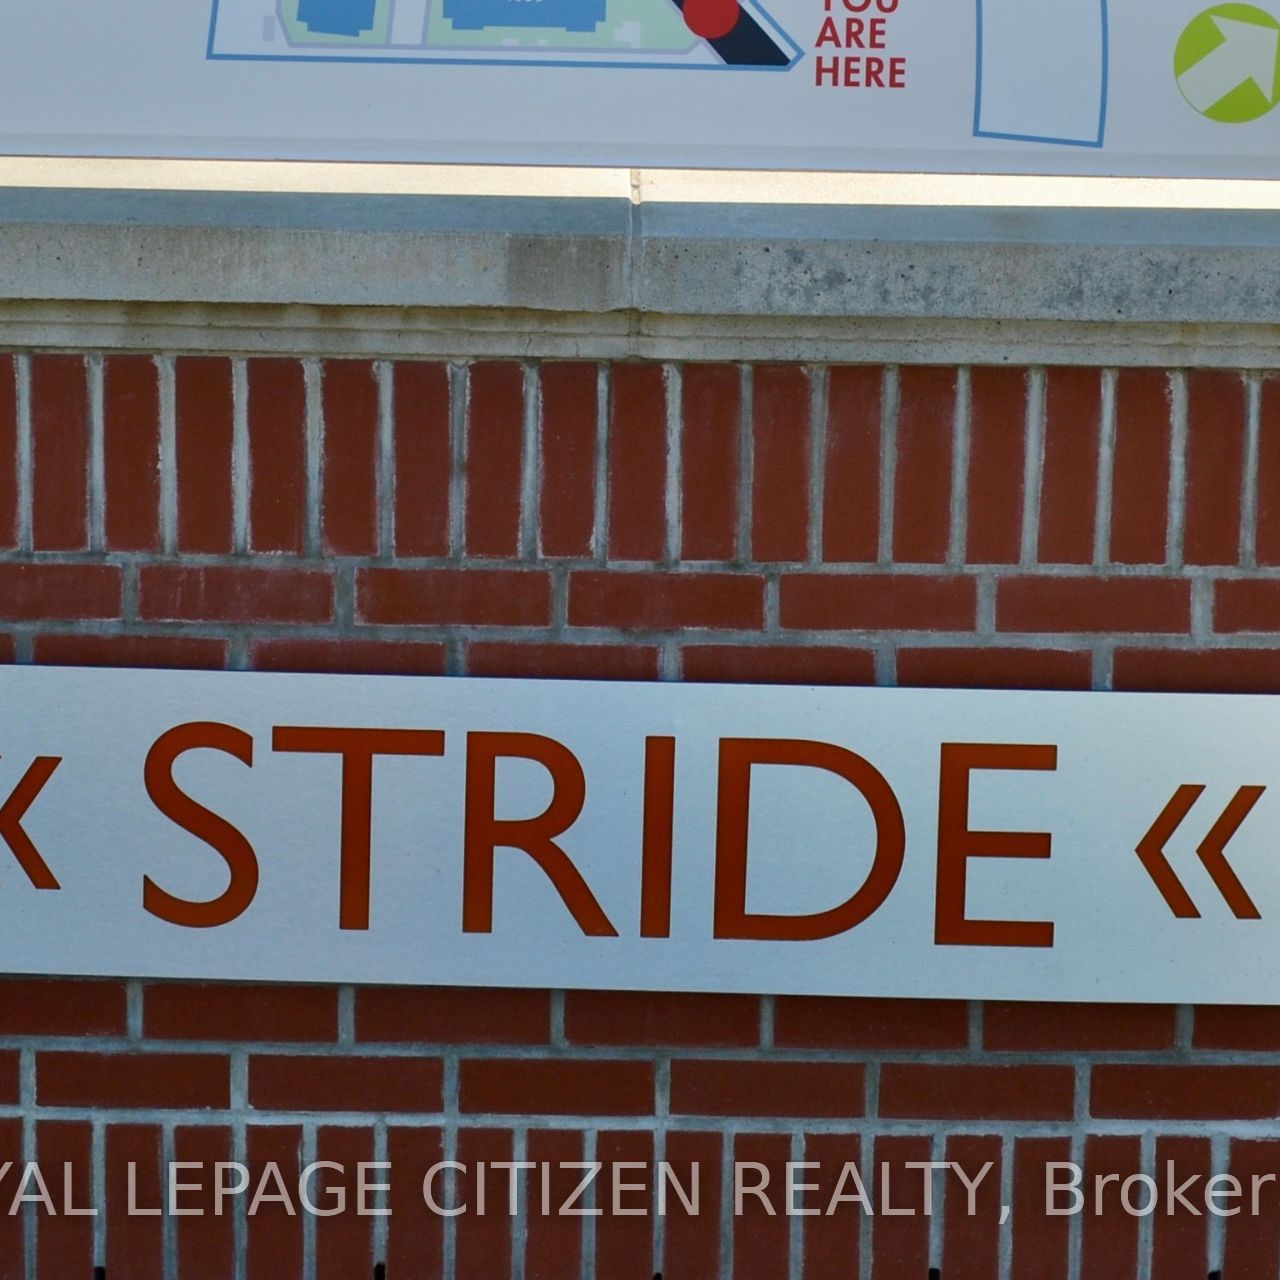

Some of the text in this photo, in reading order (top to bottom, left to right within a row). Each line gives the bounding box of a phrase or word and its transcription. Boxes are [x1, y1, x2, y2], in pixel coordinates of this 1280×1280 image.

[814, 16, 886, 49] ARE
[815, 55, 906, 88] HERE
[143, 721, 1058, 947] STRIDE
